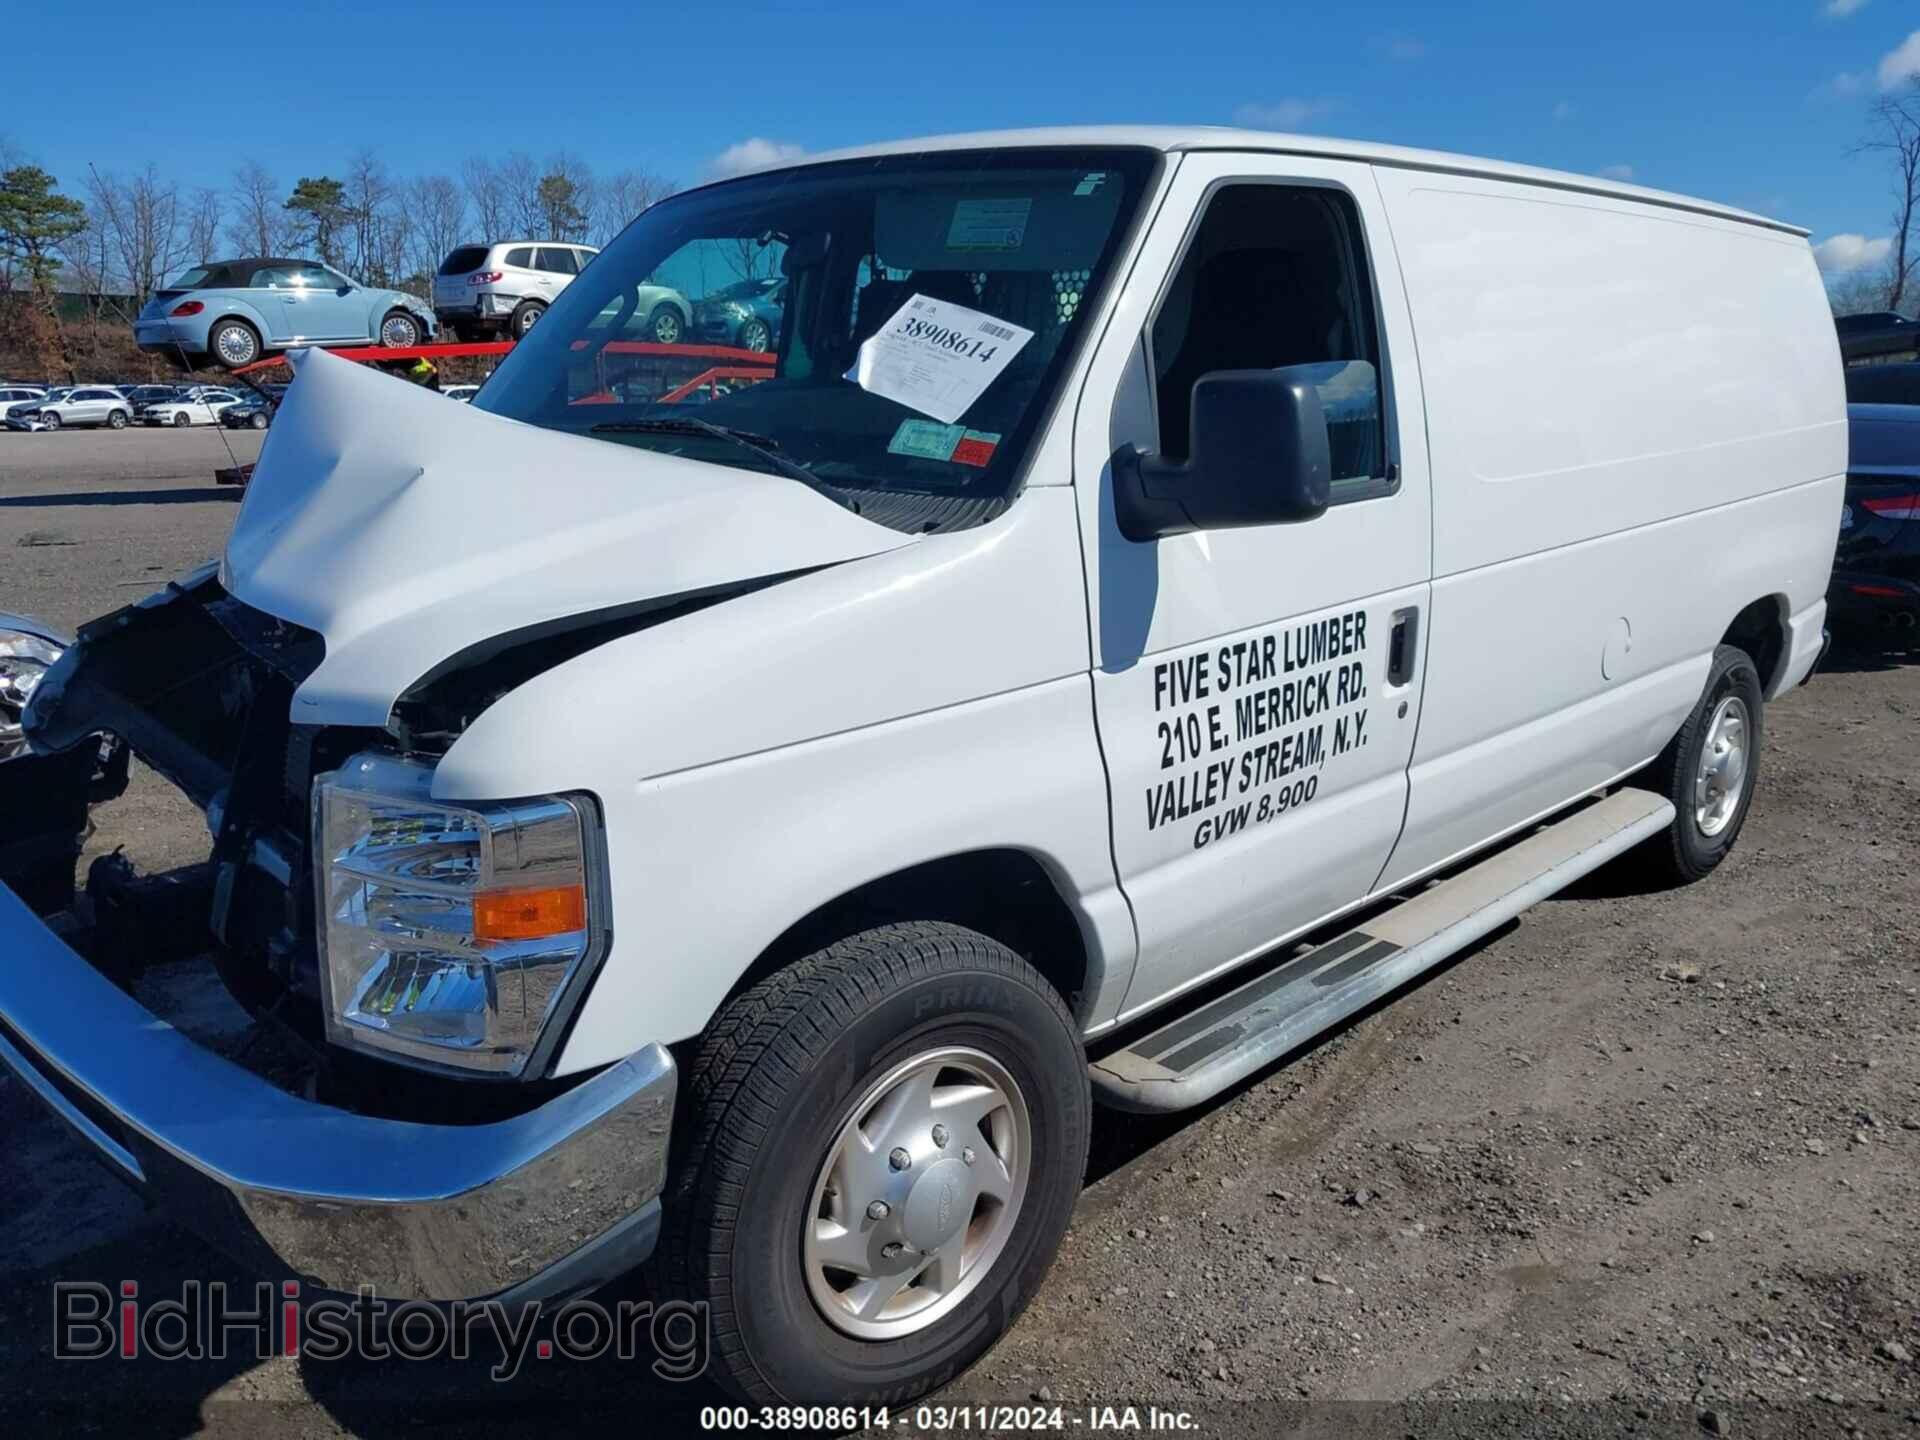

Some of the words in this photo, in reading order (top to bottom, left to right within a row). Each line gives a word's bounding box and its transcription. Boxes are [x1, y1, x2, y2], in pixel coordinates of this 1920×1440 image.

[896, 317, 998, 363] 38908614
[1154, 652, 1209, 711] FIVE
[1217, 635, 1276, 692] STAR
[1284, 611, 1366, 673] LUMBER
[1158, 712, 1201, 769] 210
[1207, 705, 1229, 751] E.
[1235, 670, 1331, 742] MERRICK
[1337, 661, 1367, 706] RD.
[1146, 757, 1235, 831] VALLEY
[1239, 724, 1326, 793] STREAM,
[1194, 801, 1252, 850] GVW
[1256, 775, 1318, 823] 8,900
